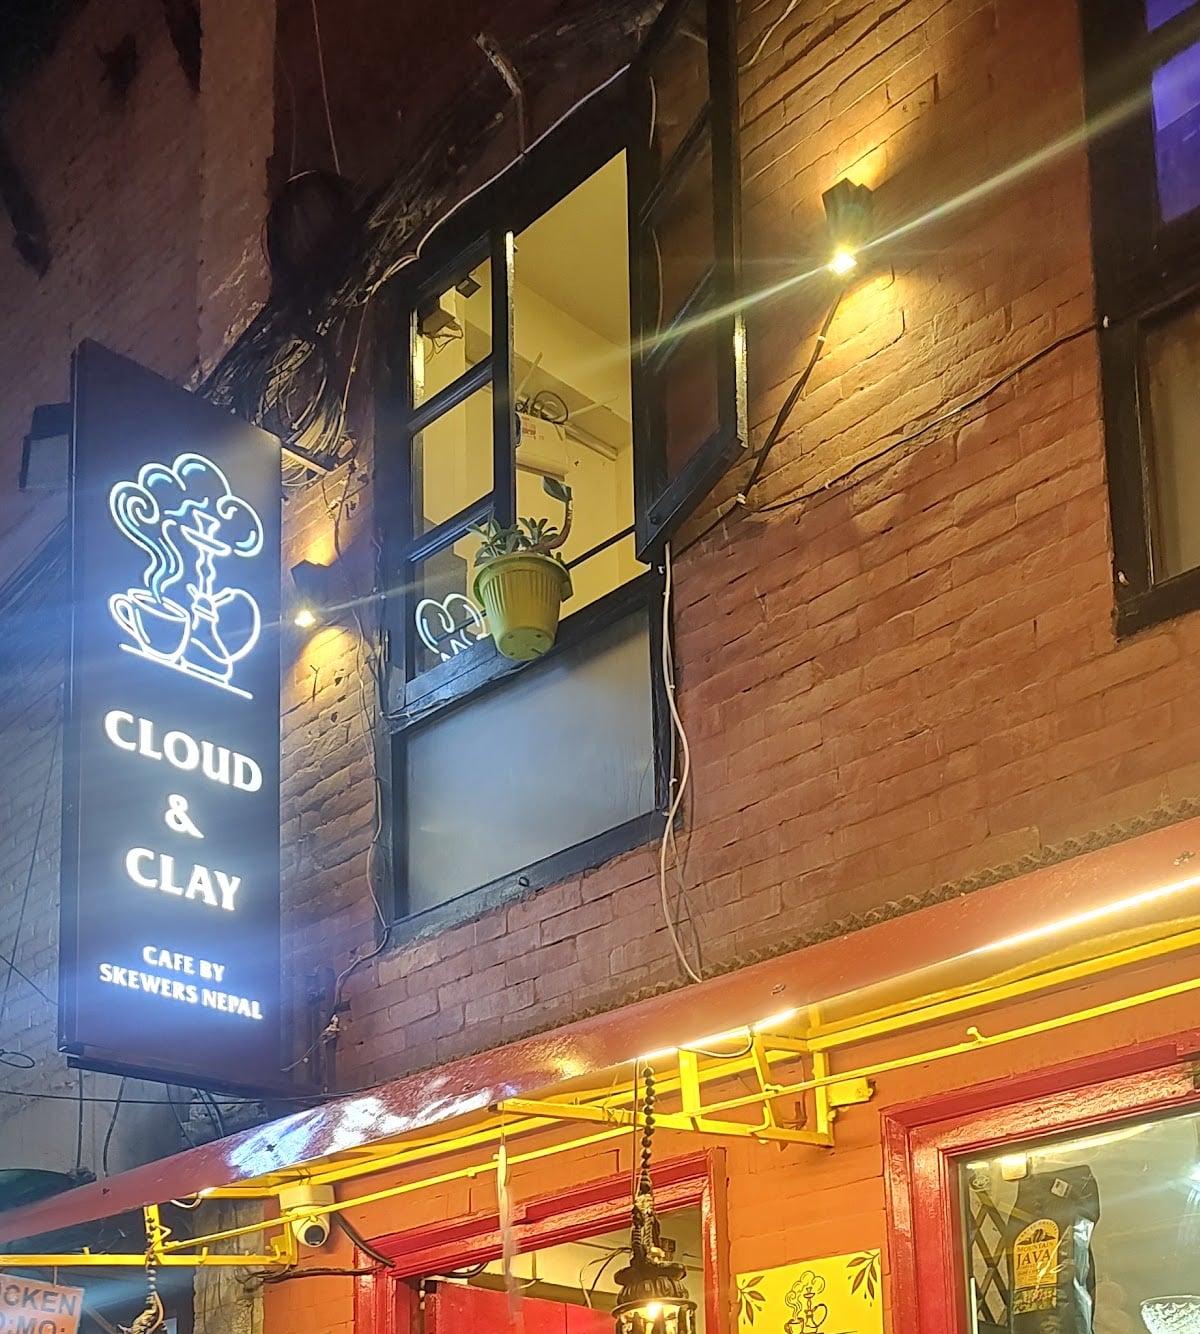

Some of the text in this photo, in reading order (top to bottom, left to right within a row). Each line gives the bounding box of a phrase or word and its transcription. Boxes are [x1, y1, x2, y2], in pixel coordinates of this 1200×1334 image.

[104, 709, 263, 793] CLOUD
[164, 794, 204, 839] &
[125, 846, 241, 912] CLAY
[142, 945, 225, 982] CAFE BY
[99, 963, 263, 1020] SKEWERS NEPAL
[1017, 1249, 1051, 1271] JAVA
[0, 1282, 77, 1316] CKEN
